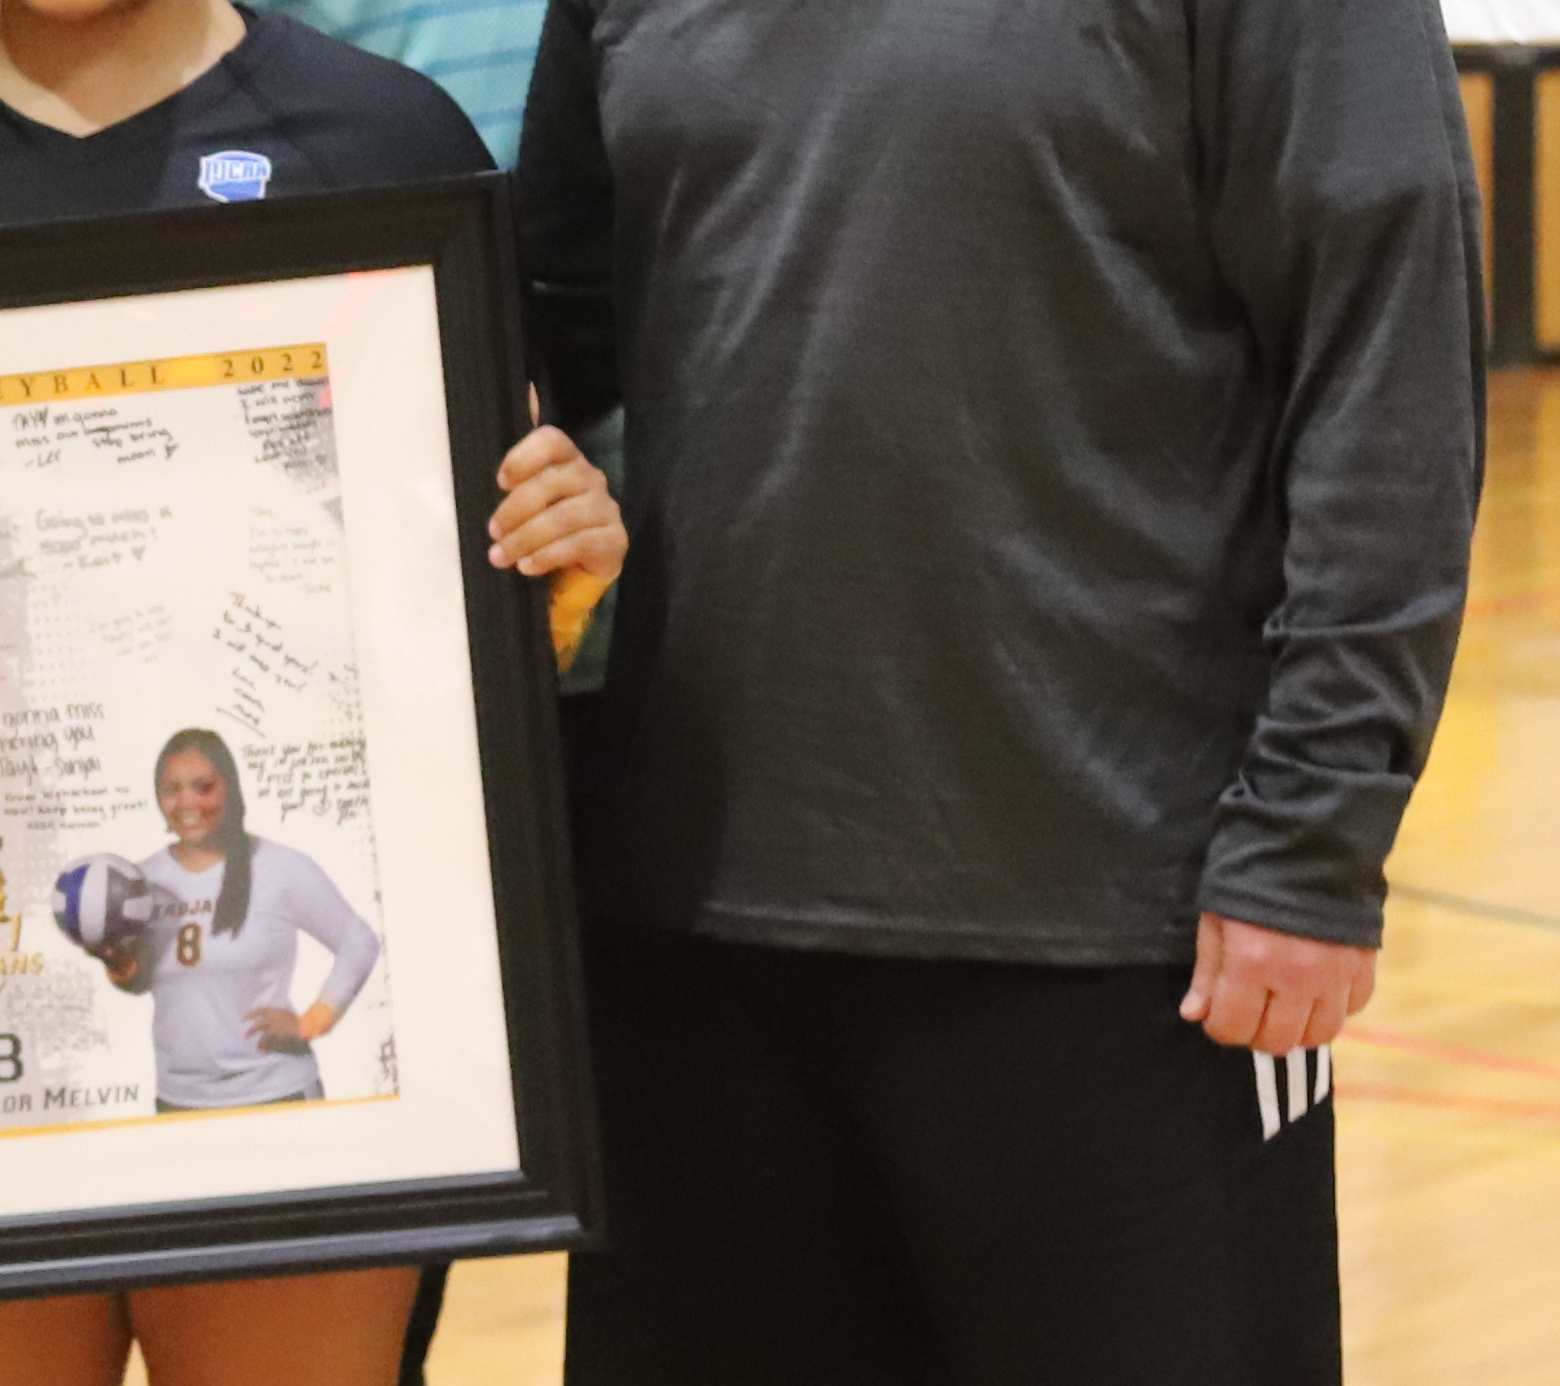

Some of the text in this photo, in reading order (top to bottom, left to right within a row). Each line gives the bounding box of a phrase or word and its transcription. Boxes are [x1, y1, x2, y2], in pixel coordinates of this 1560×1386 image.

[222, 350, 324, 379] 2022
[176, 923, 203, 968] 8
[42, 1084, 140, 1111] MELVIN
